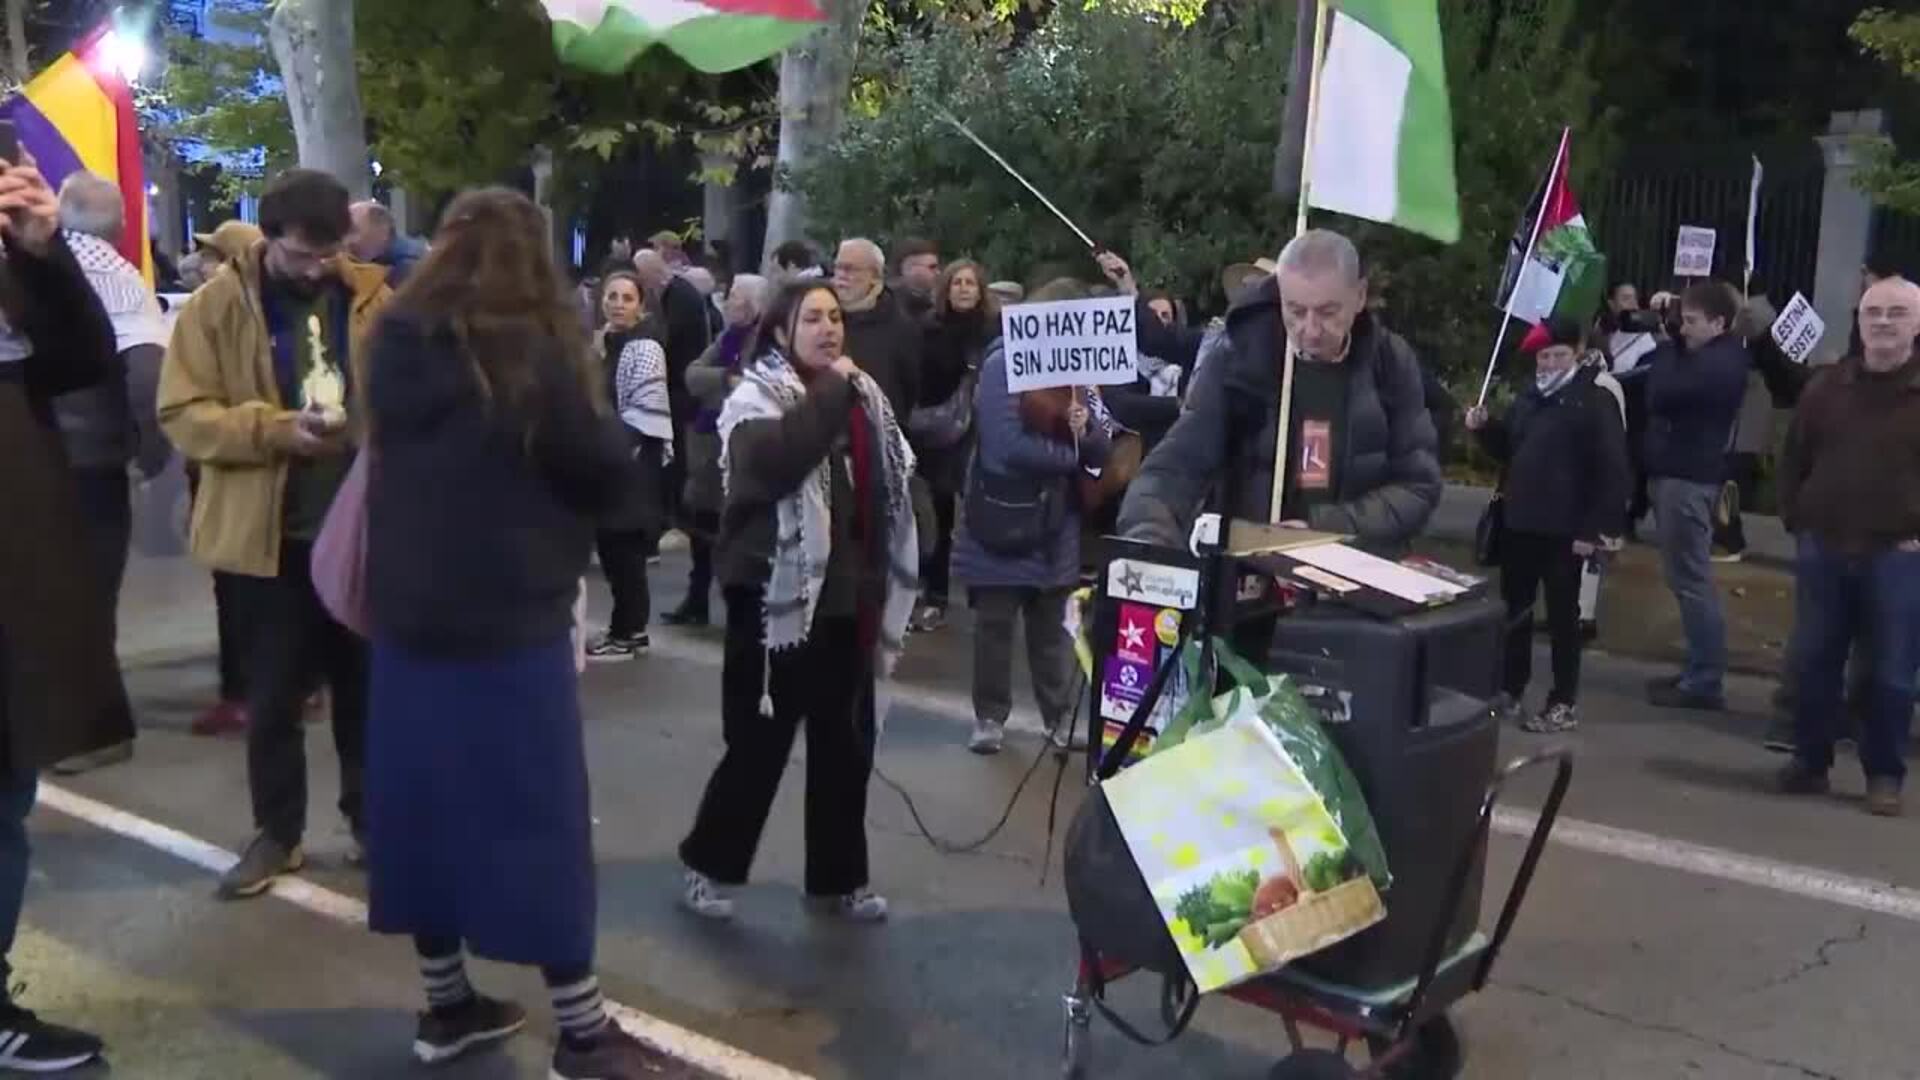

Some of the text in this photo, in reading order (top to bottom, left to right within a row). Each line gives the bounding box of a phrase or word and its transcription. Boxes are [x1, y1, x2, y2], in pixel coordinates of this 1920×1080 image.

[1009, 308, 1132, 340] NO HAY PAZ
[1787, 321, 1816, 360] SISTE!
[1012, 345, 1133, 376] SIN JUSTICIA.
